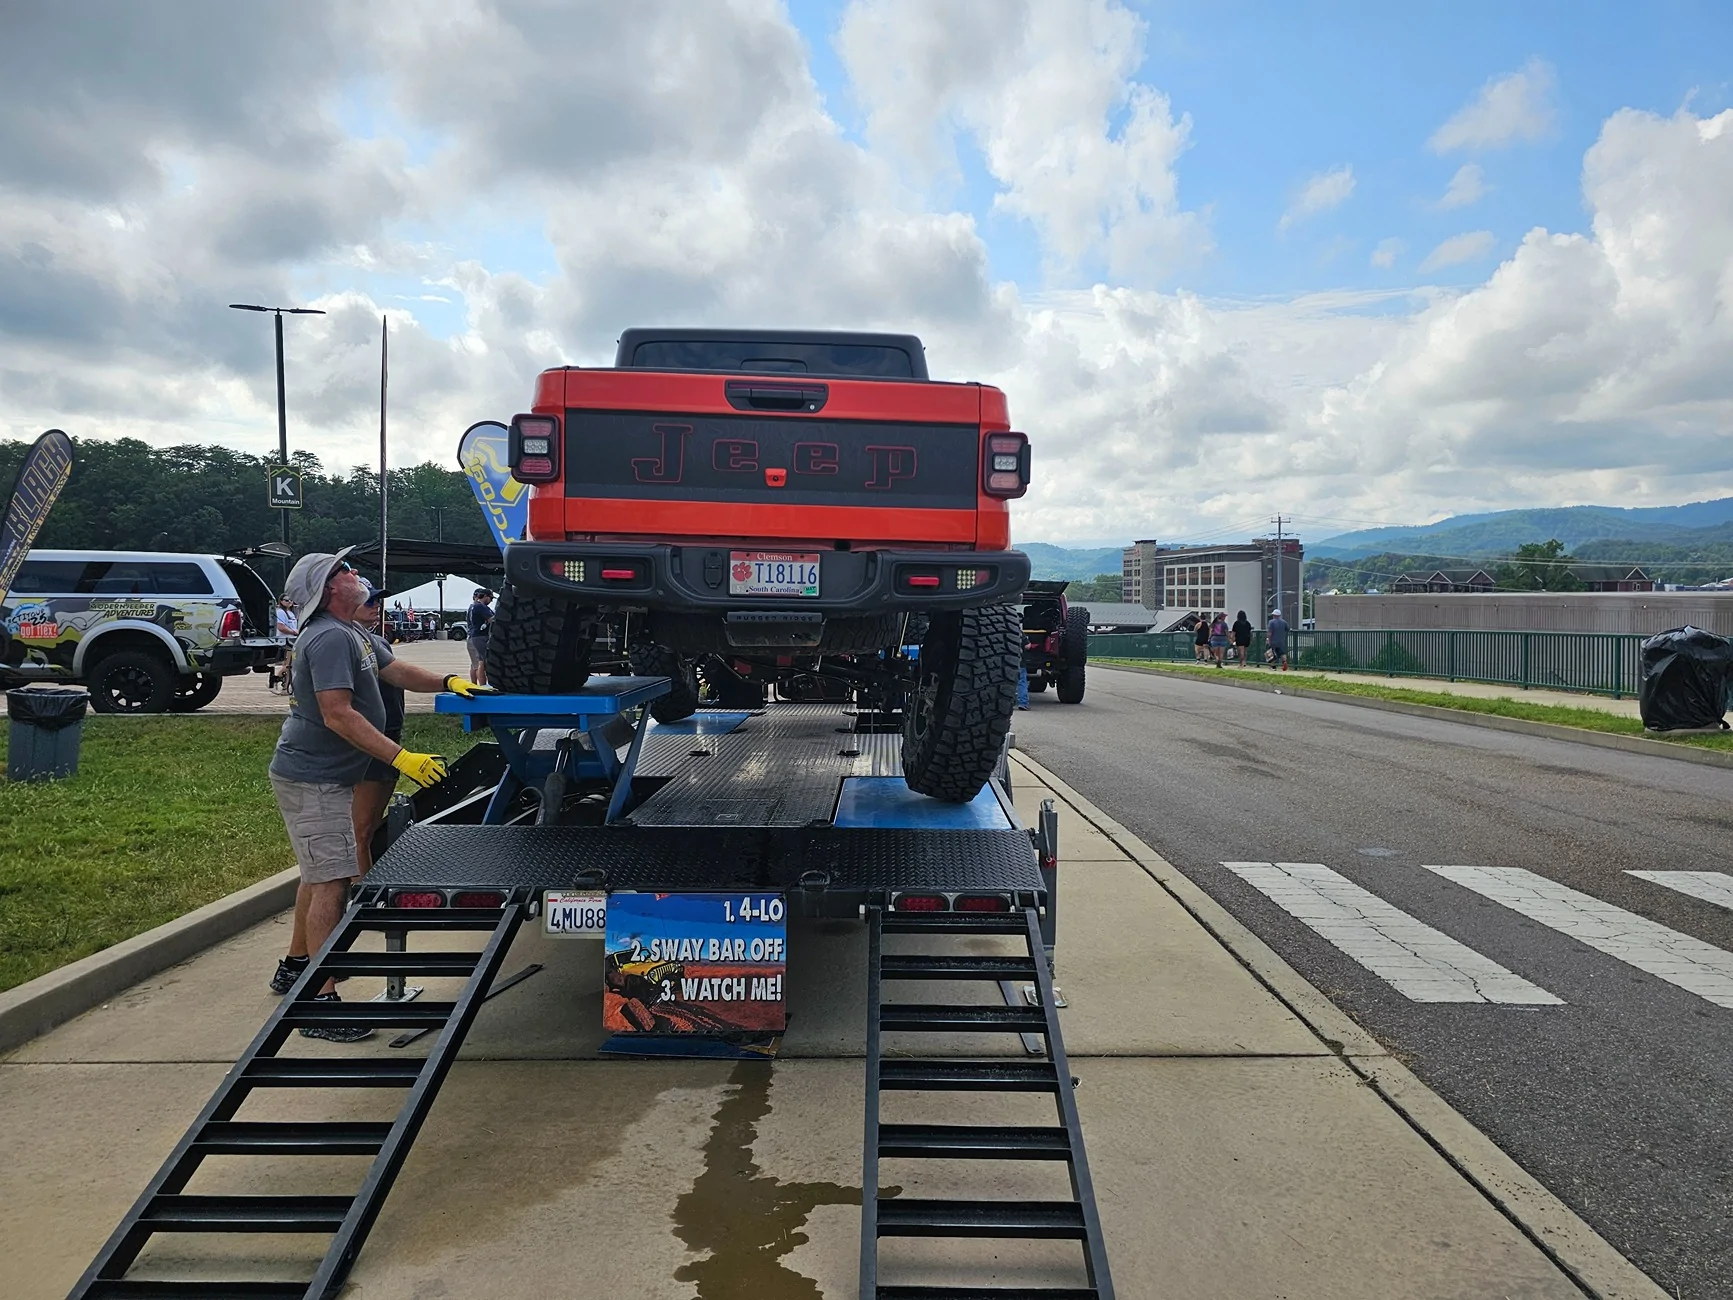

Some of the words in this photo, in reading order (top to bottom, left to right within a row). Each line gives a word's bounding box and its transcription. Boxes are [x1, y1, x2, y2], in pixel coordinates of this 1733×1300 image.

[631, 423, 917, 489] Jeep
[6, 433, 70, 543] BLACK
[276, 477, 294, 496] K
[757, 552, 793, 561] Clemson
[754, 563, 817, 585] T18116
[770, 585, 800, 594] Carolina
[102, 609, 155, 619] ADVENTURES
[20, 624, 38, 638] got
[724, 900, 735, 922] 1.
[739, 896, 784, 922] 4-LO
[630, 940, 646, 962] 2.
[650, 938, 704, 962] SWAY
[708, 938, 746, 962] BAR
[750, 938, 783, 962] OFF
[660, 979, 676, 1001] 3.
[680, 977, 746, 1001] WATCH
[751, 974, 782, 1001] ME!
